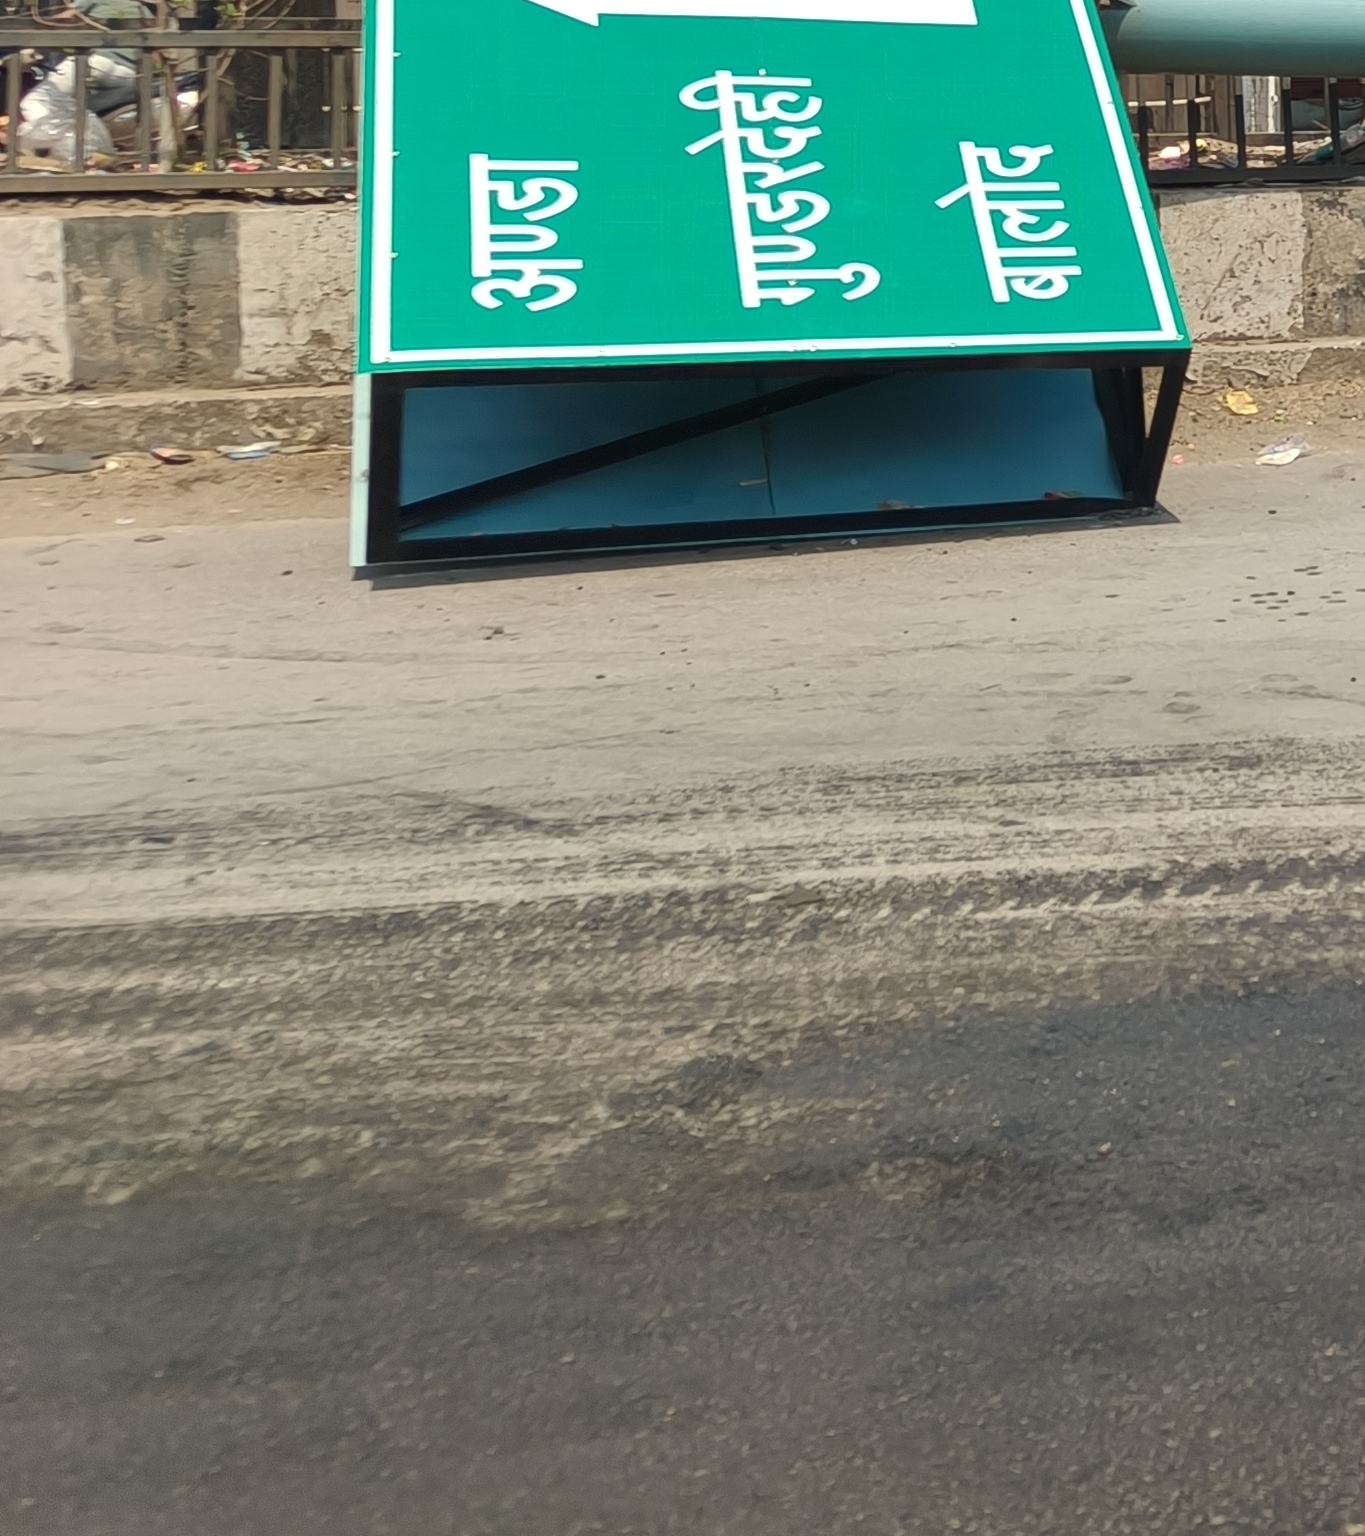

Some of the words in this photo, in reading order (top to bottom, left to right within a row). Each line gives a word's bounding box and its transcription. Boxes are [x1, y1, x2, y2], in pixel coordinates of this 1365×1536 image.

[469, 153, 585, 312] अण्डा
[678, 69, 881, 309] गुण्डरदेही
[933, 140, 1083, 303] बालोद
